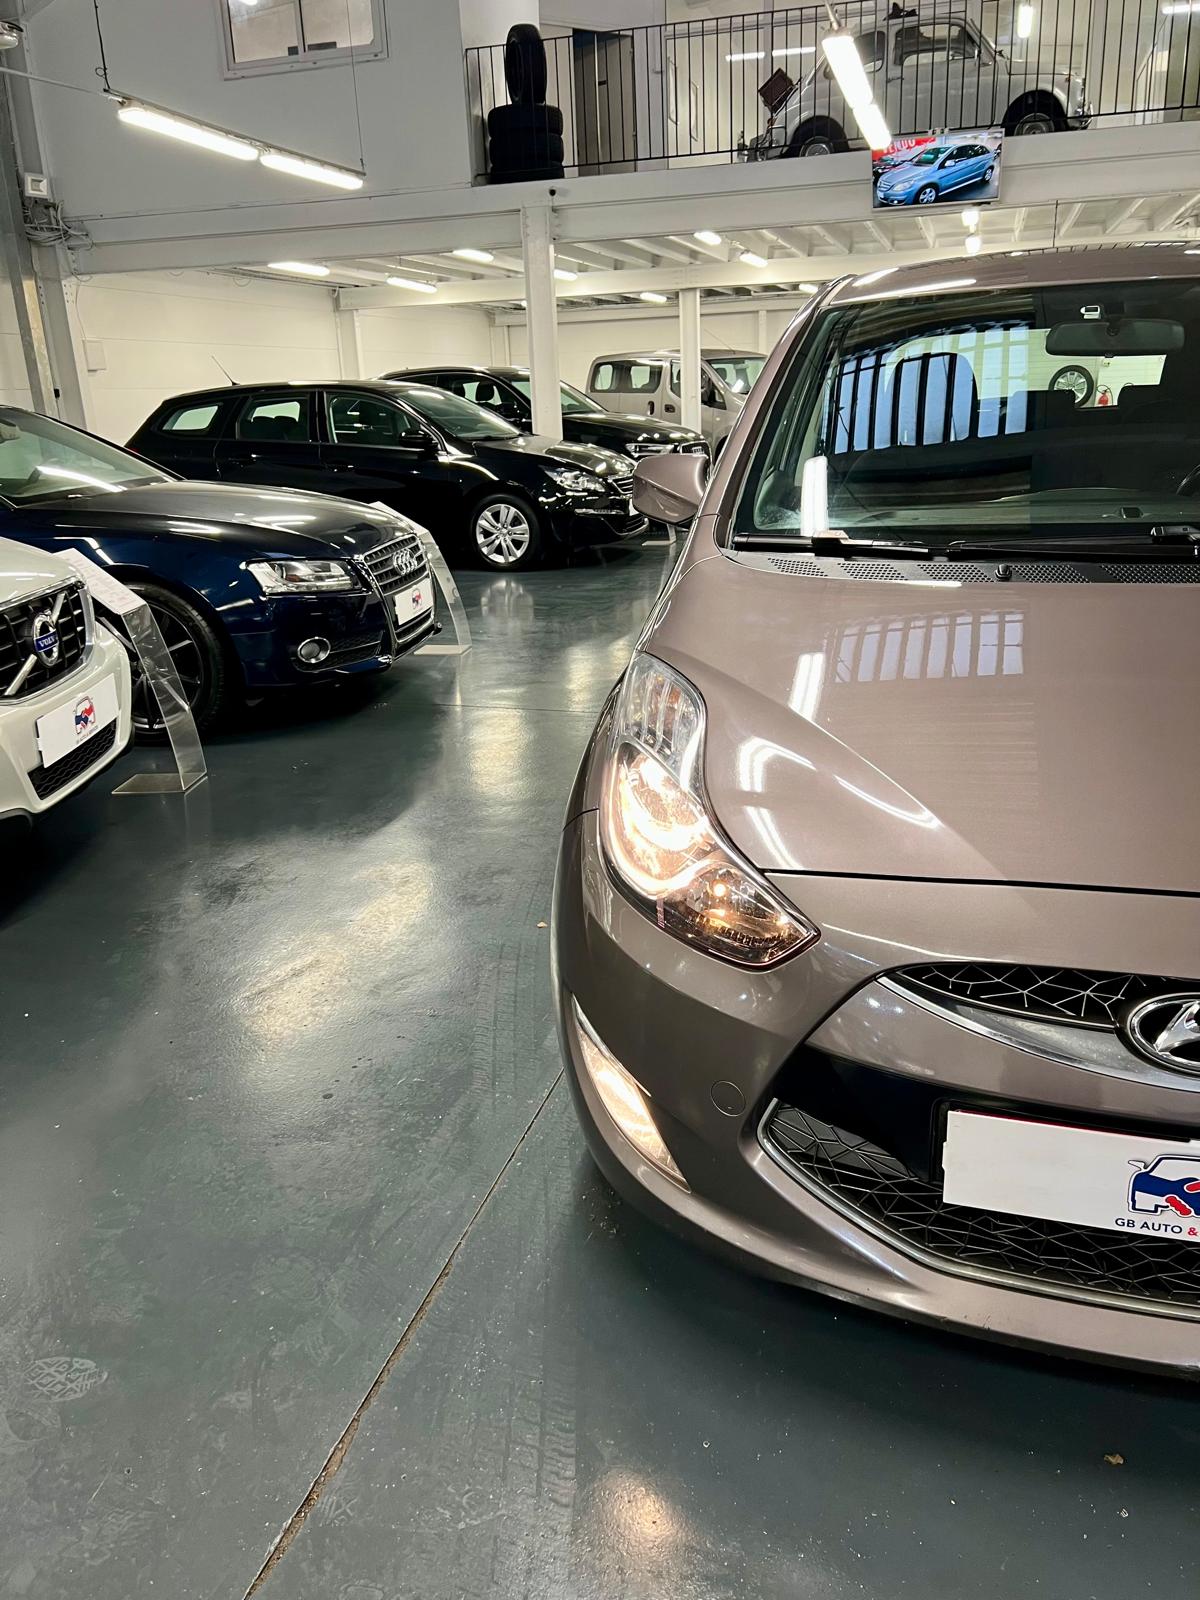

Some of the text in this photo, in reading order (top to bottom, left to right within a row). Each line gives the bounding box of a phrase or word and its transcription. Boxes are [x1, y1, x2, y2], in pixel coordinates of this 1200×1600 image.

[882, 138, 916, 154] ENDU
[1115, 1217, 1198, 1236] GB AUTO &
